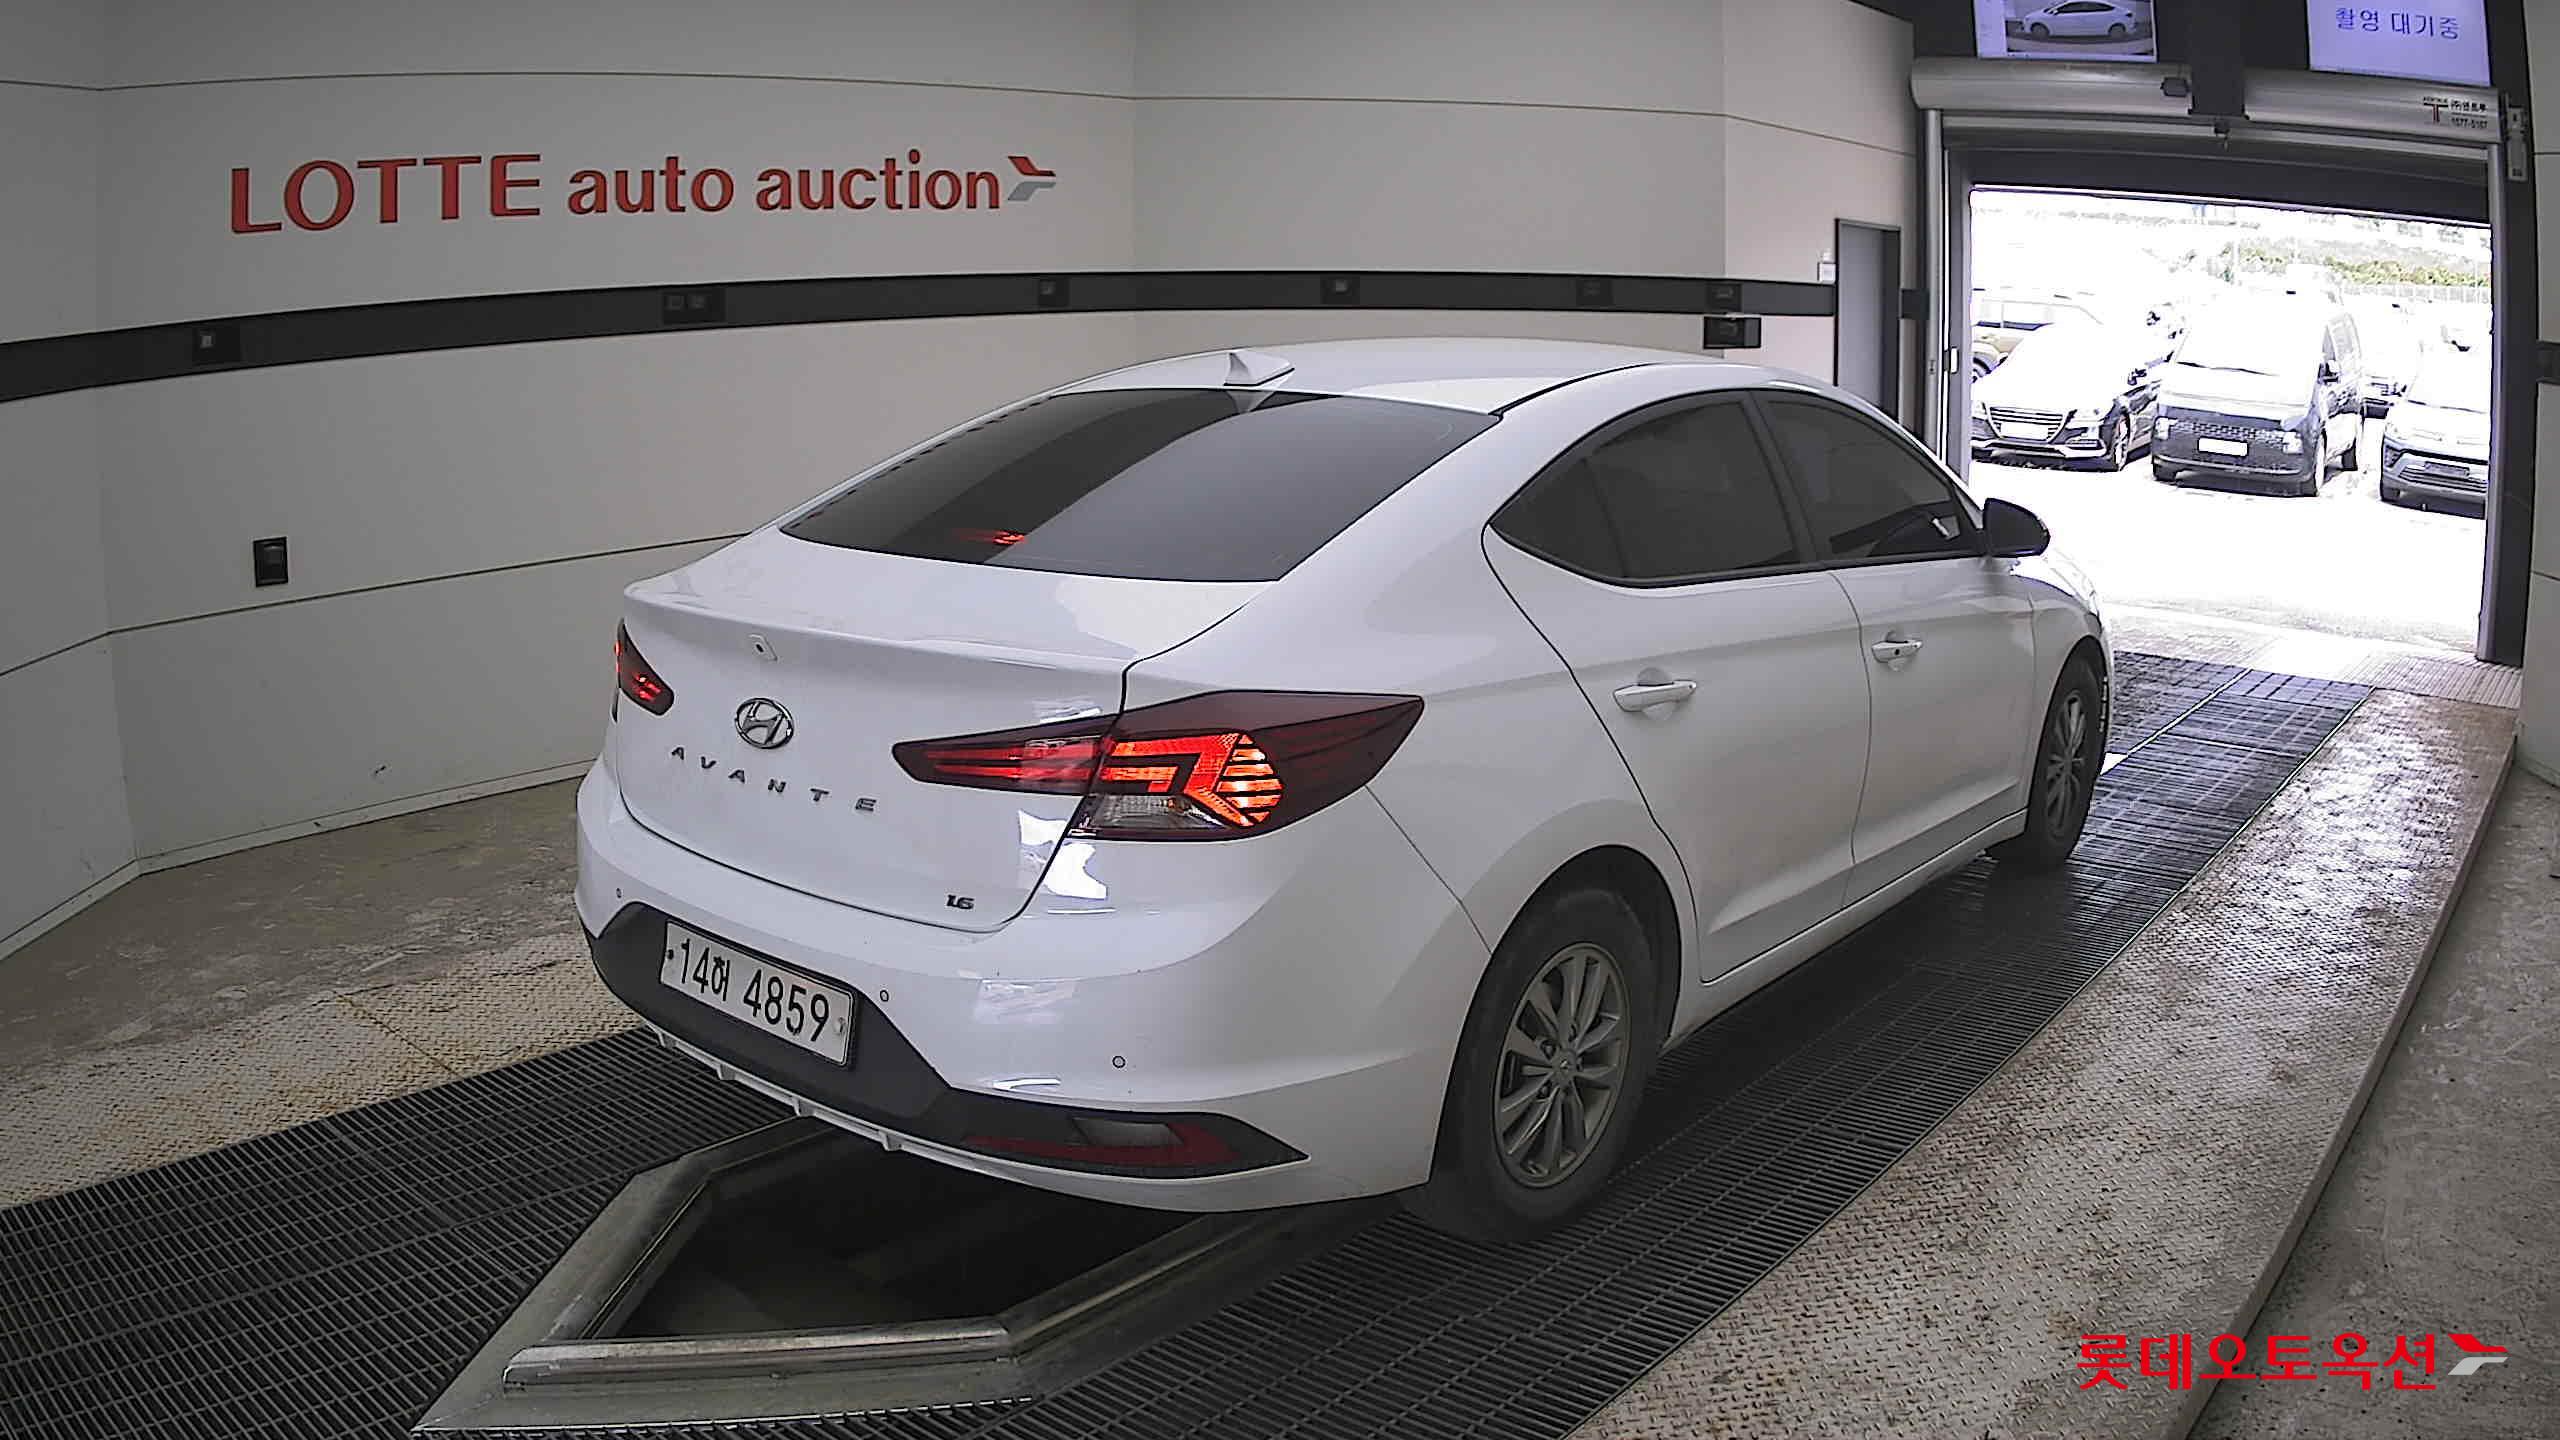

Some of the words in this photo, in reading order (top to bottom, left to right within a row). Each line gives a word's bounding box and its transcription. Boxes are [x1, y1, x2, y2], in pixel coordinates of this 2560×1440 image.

[2335, 7, 2380, 32] 촬영
[2391, 12, 2460, 40] 대기중
[230, 154, 541, 235] LOTTE
[566, 156, 735, 215] auto
[754, 148, 1002, 213] auction
[670, 746, 878, 813] AVANTE
[680, 937, 732, 1002] 14허
[743, 968, 830, 1042] 4859
